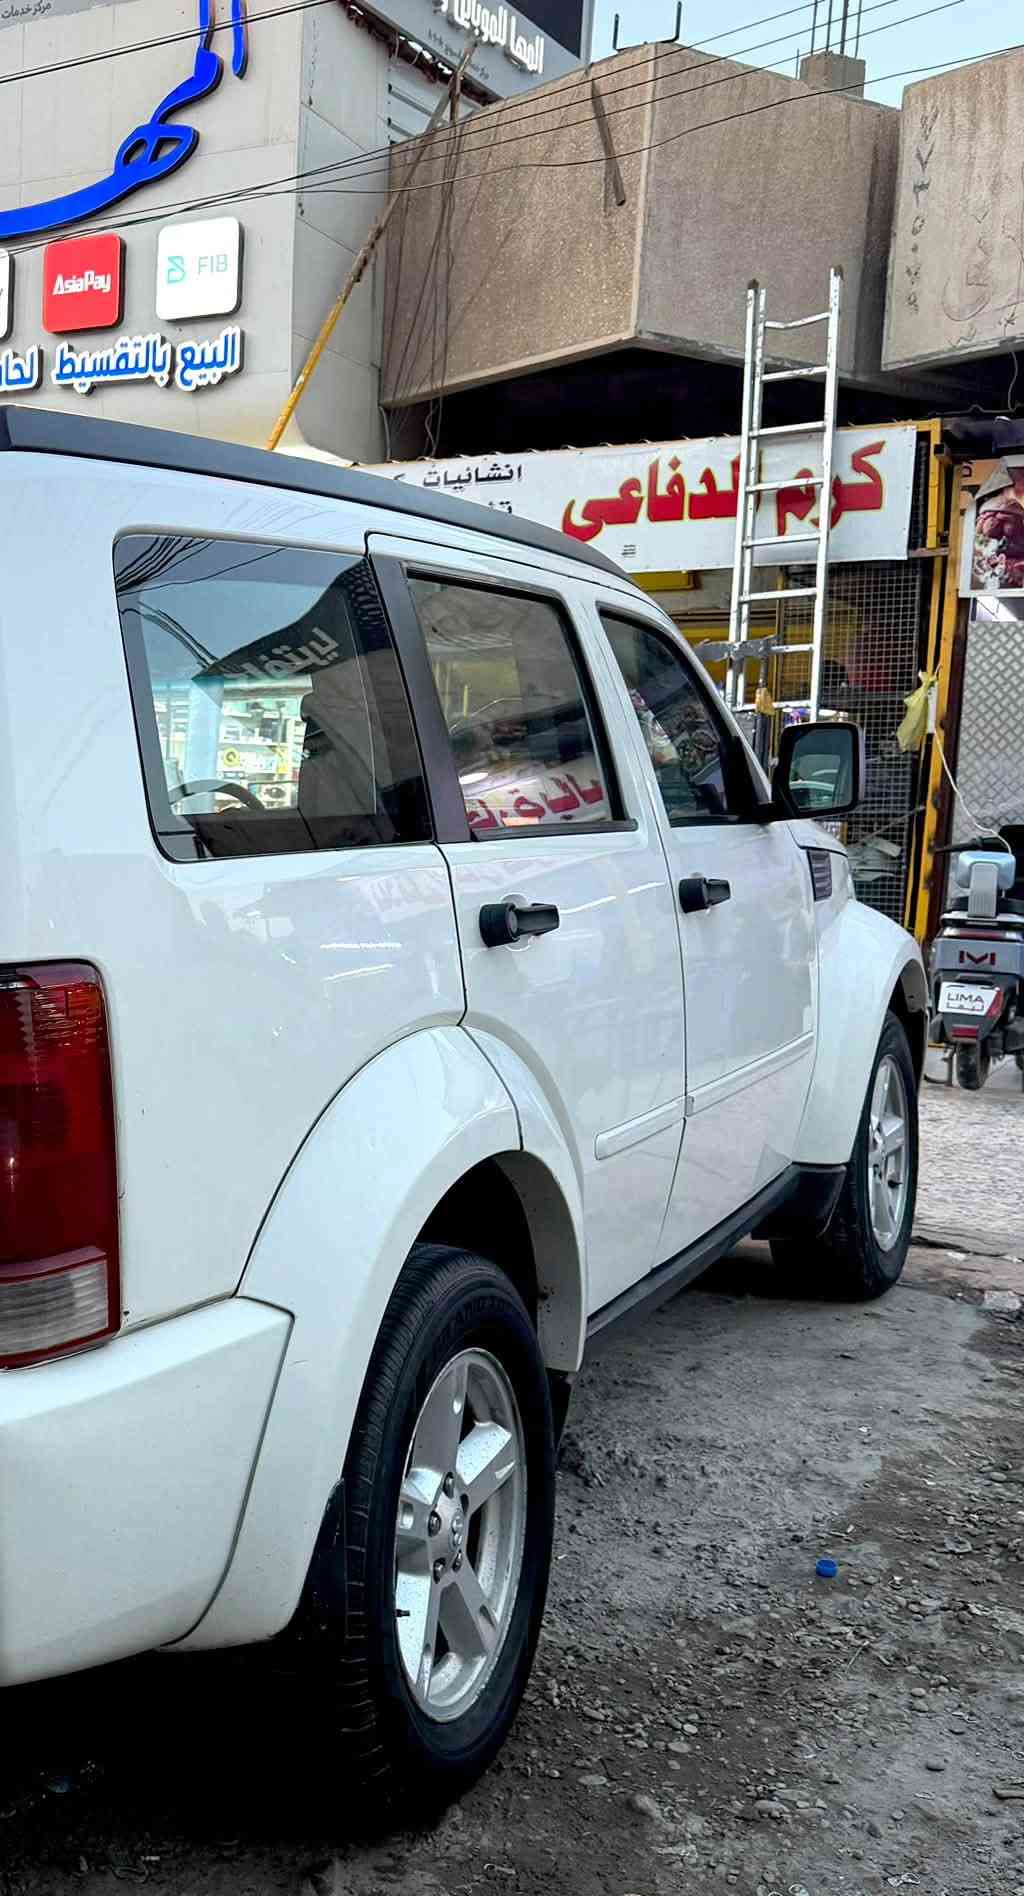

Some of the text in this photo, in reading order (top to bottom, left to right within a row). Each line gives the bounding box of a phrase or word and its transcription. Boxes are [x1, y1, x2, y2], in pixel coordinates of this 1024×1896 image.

[52, 270, 112, 296] AsiaPay
[197, 253, 228, 277] FIB
[52, 332, 172, 394] بالتقسيط
[177, 325, 241, 391] البيع
[776, 440, 887, 537] كرم
[947, 992, 984, 1004] LIMA
